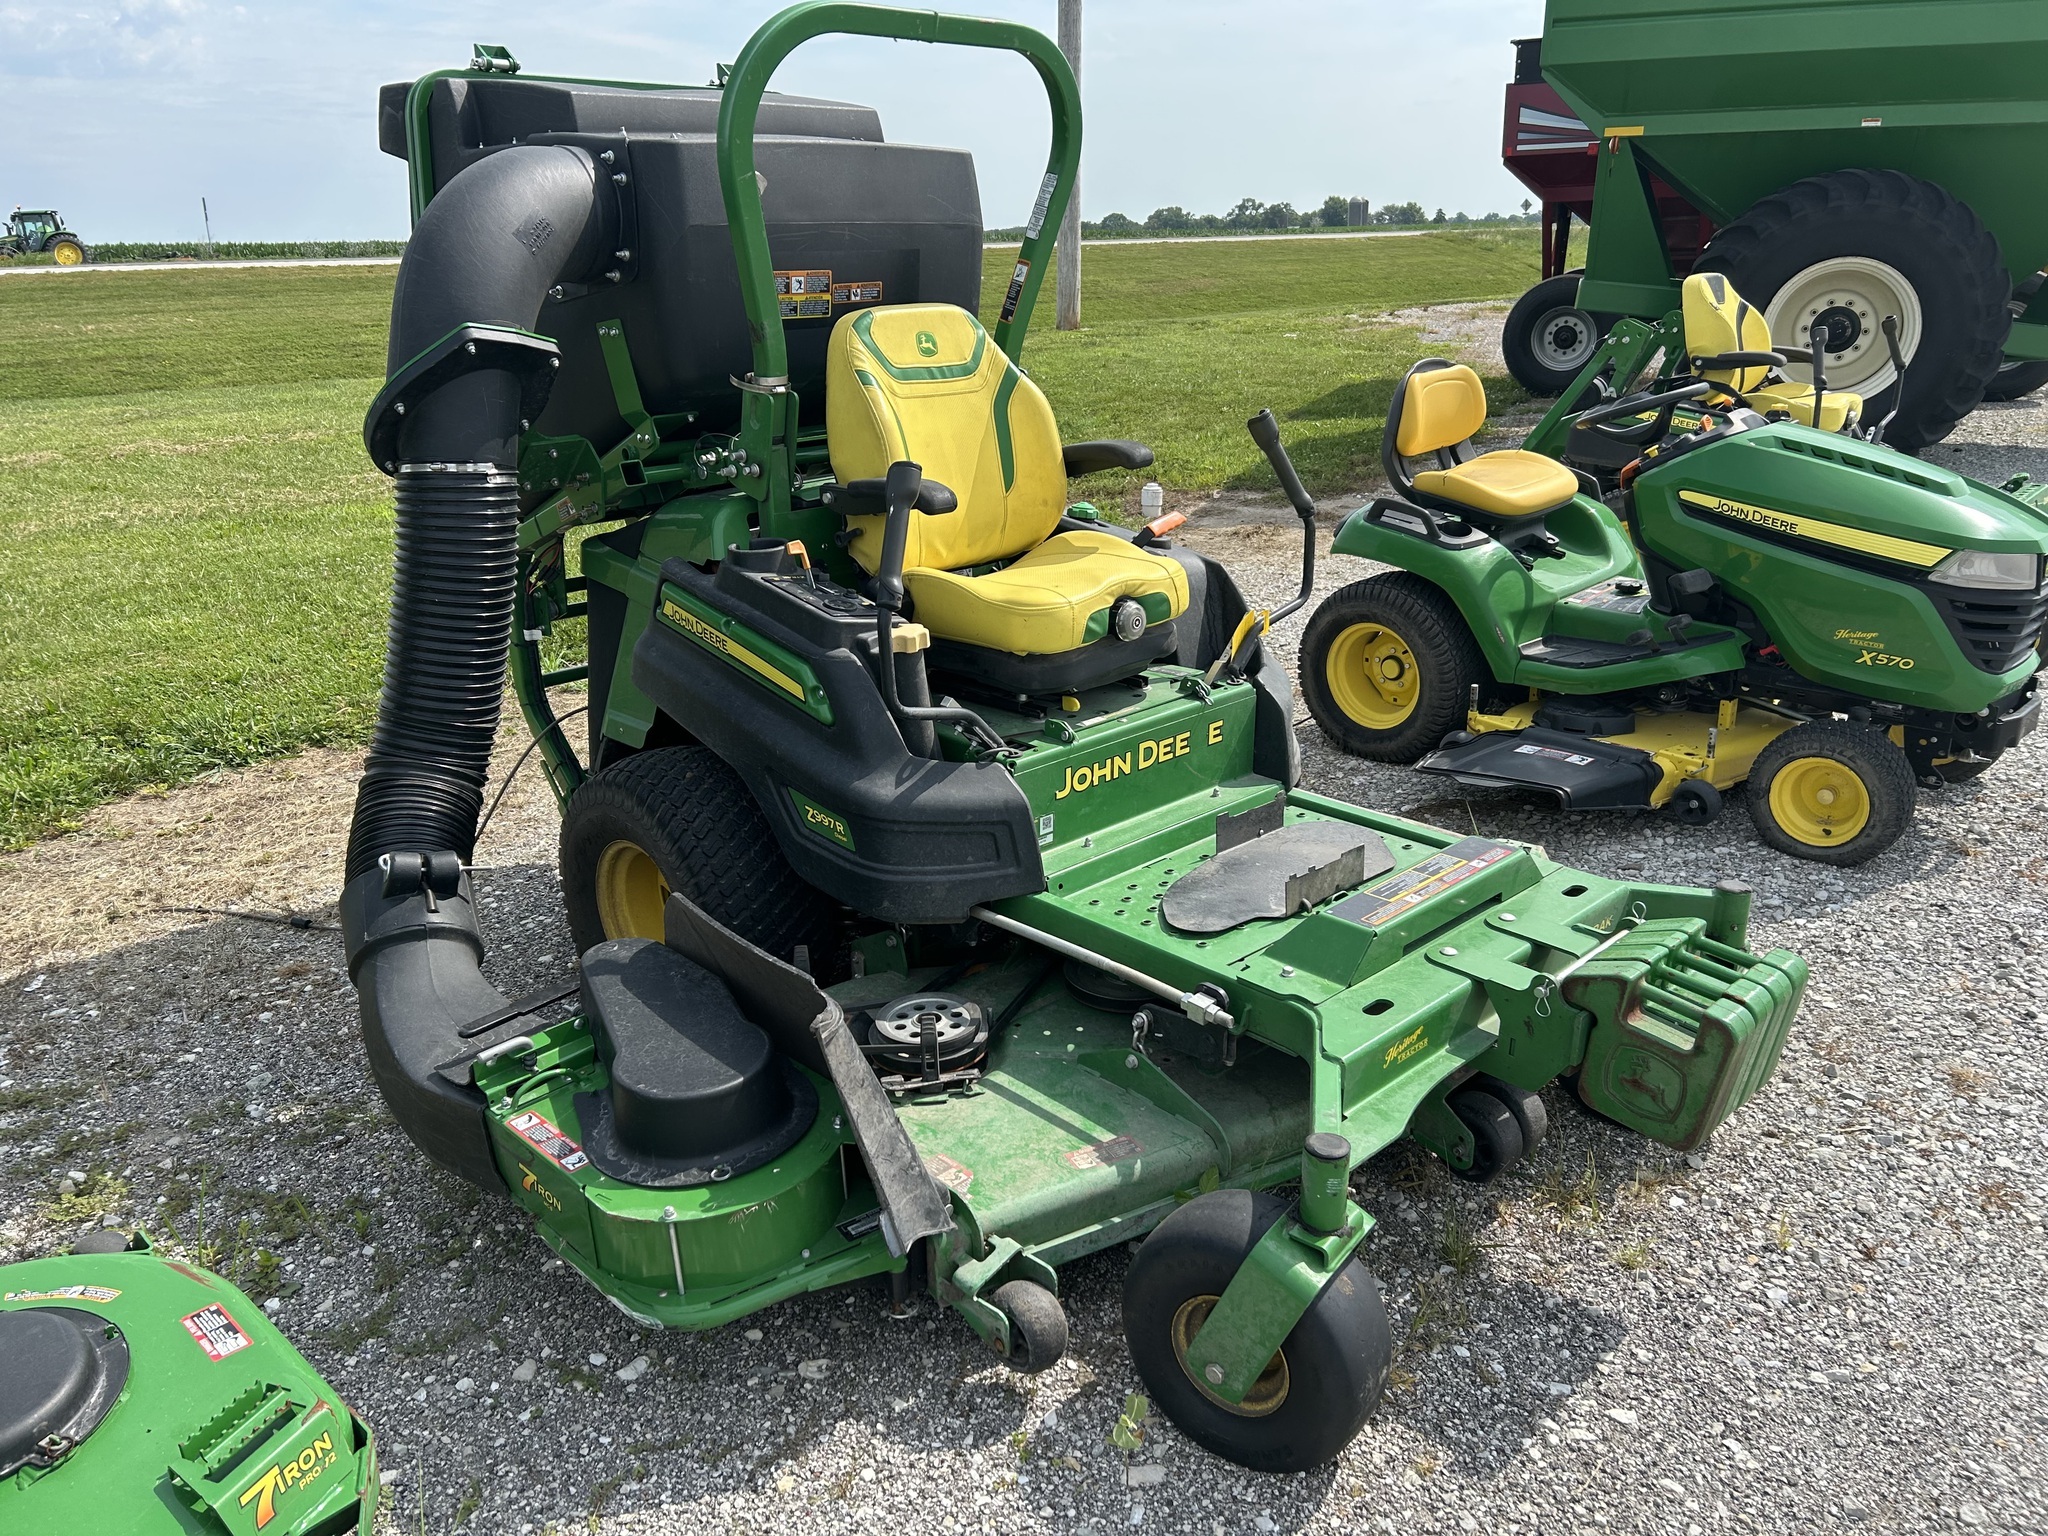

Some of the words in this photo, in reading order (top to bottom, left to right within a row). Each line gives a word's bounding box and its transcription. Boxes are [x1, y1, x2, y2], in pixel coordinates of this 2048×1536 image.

[1714, 500, 1750, 520] JOHN
[1752, 510, 1799, 533] DEERE
[669, 606, 695, 633] JOHN
[696, 622, 728, 652] DEERE
[1834, 629, 1879, 640] Heritage
[1849, 639, 1885, 649] TRACTOR
[1855, 649, 1914, 669] X570
[1055, 751, 1132, 800] JOHN
[804, 805, 845, 835] Z997R
[1383, 1025, 1424, 1069] Heritage
[1397, 1037, 1428, 1064] TRACTOR
